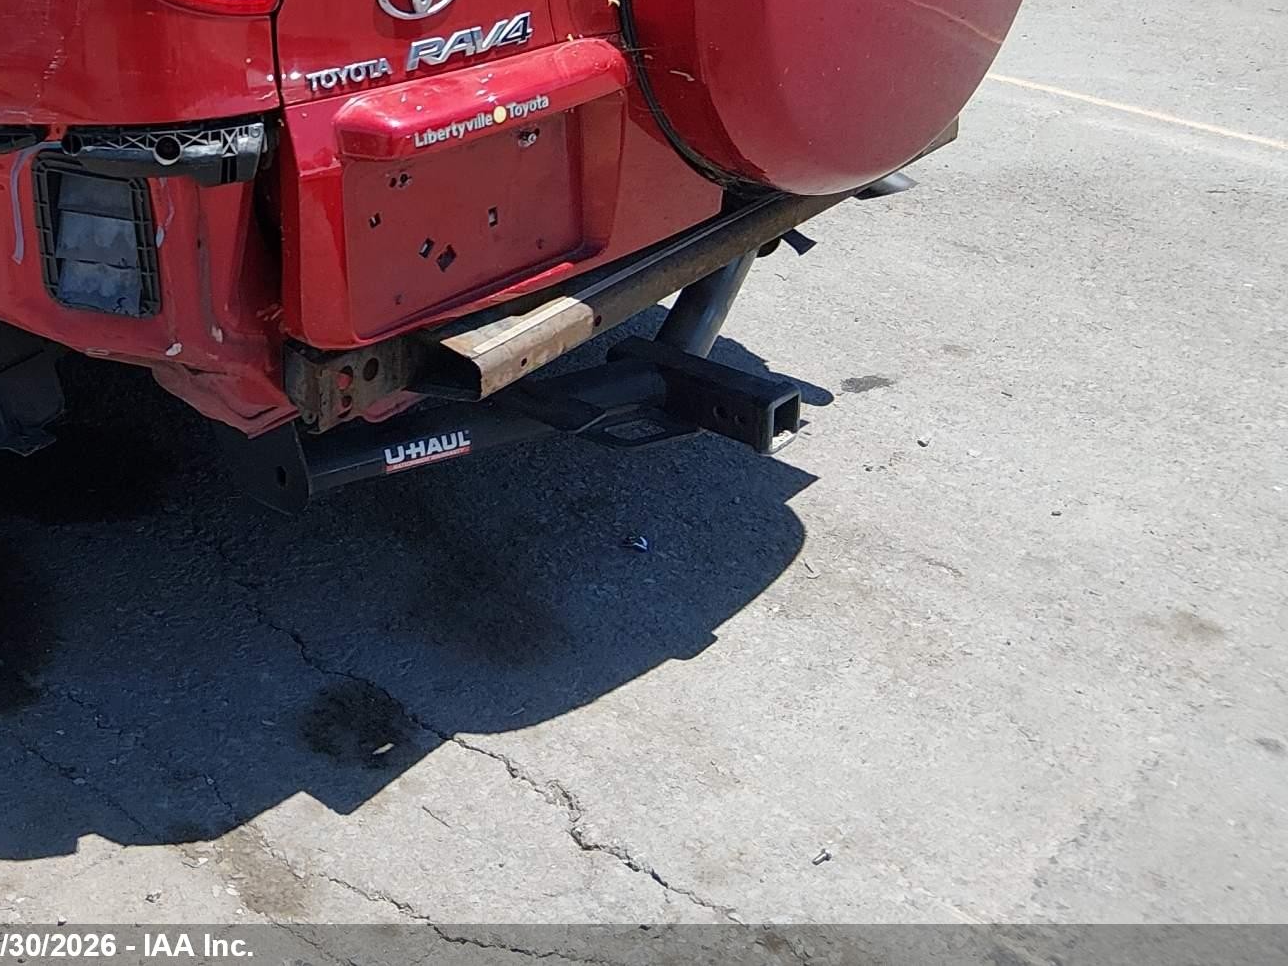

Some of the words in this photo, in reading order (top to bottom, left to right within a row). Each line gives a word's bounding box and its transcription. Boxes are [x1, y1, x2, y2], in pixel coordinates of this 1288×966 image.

[306, 57, 394, 92] TOYOTA
[406, 11, 534, 72] RAV4
[414, 113, 494, 149] Libertyville
[506, 94, 550, 119] Toyota
[383, 431, 472, 465] U-HAUL
